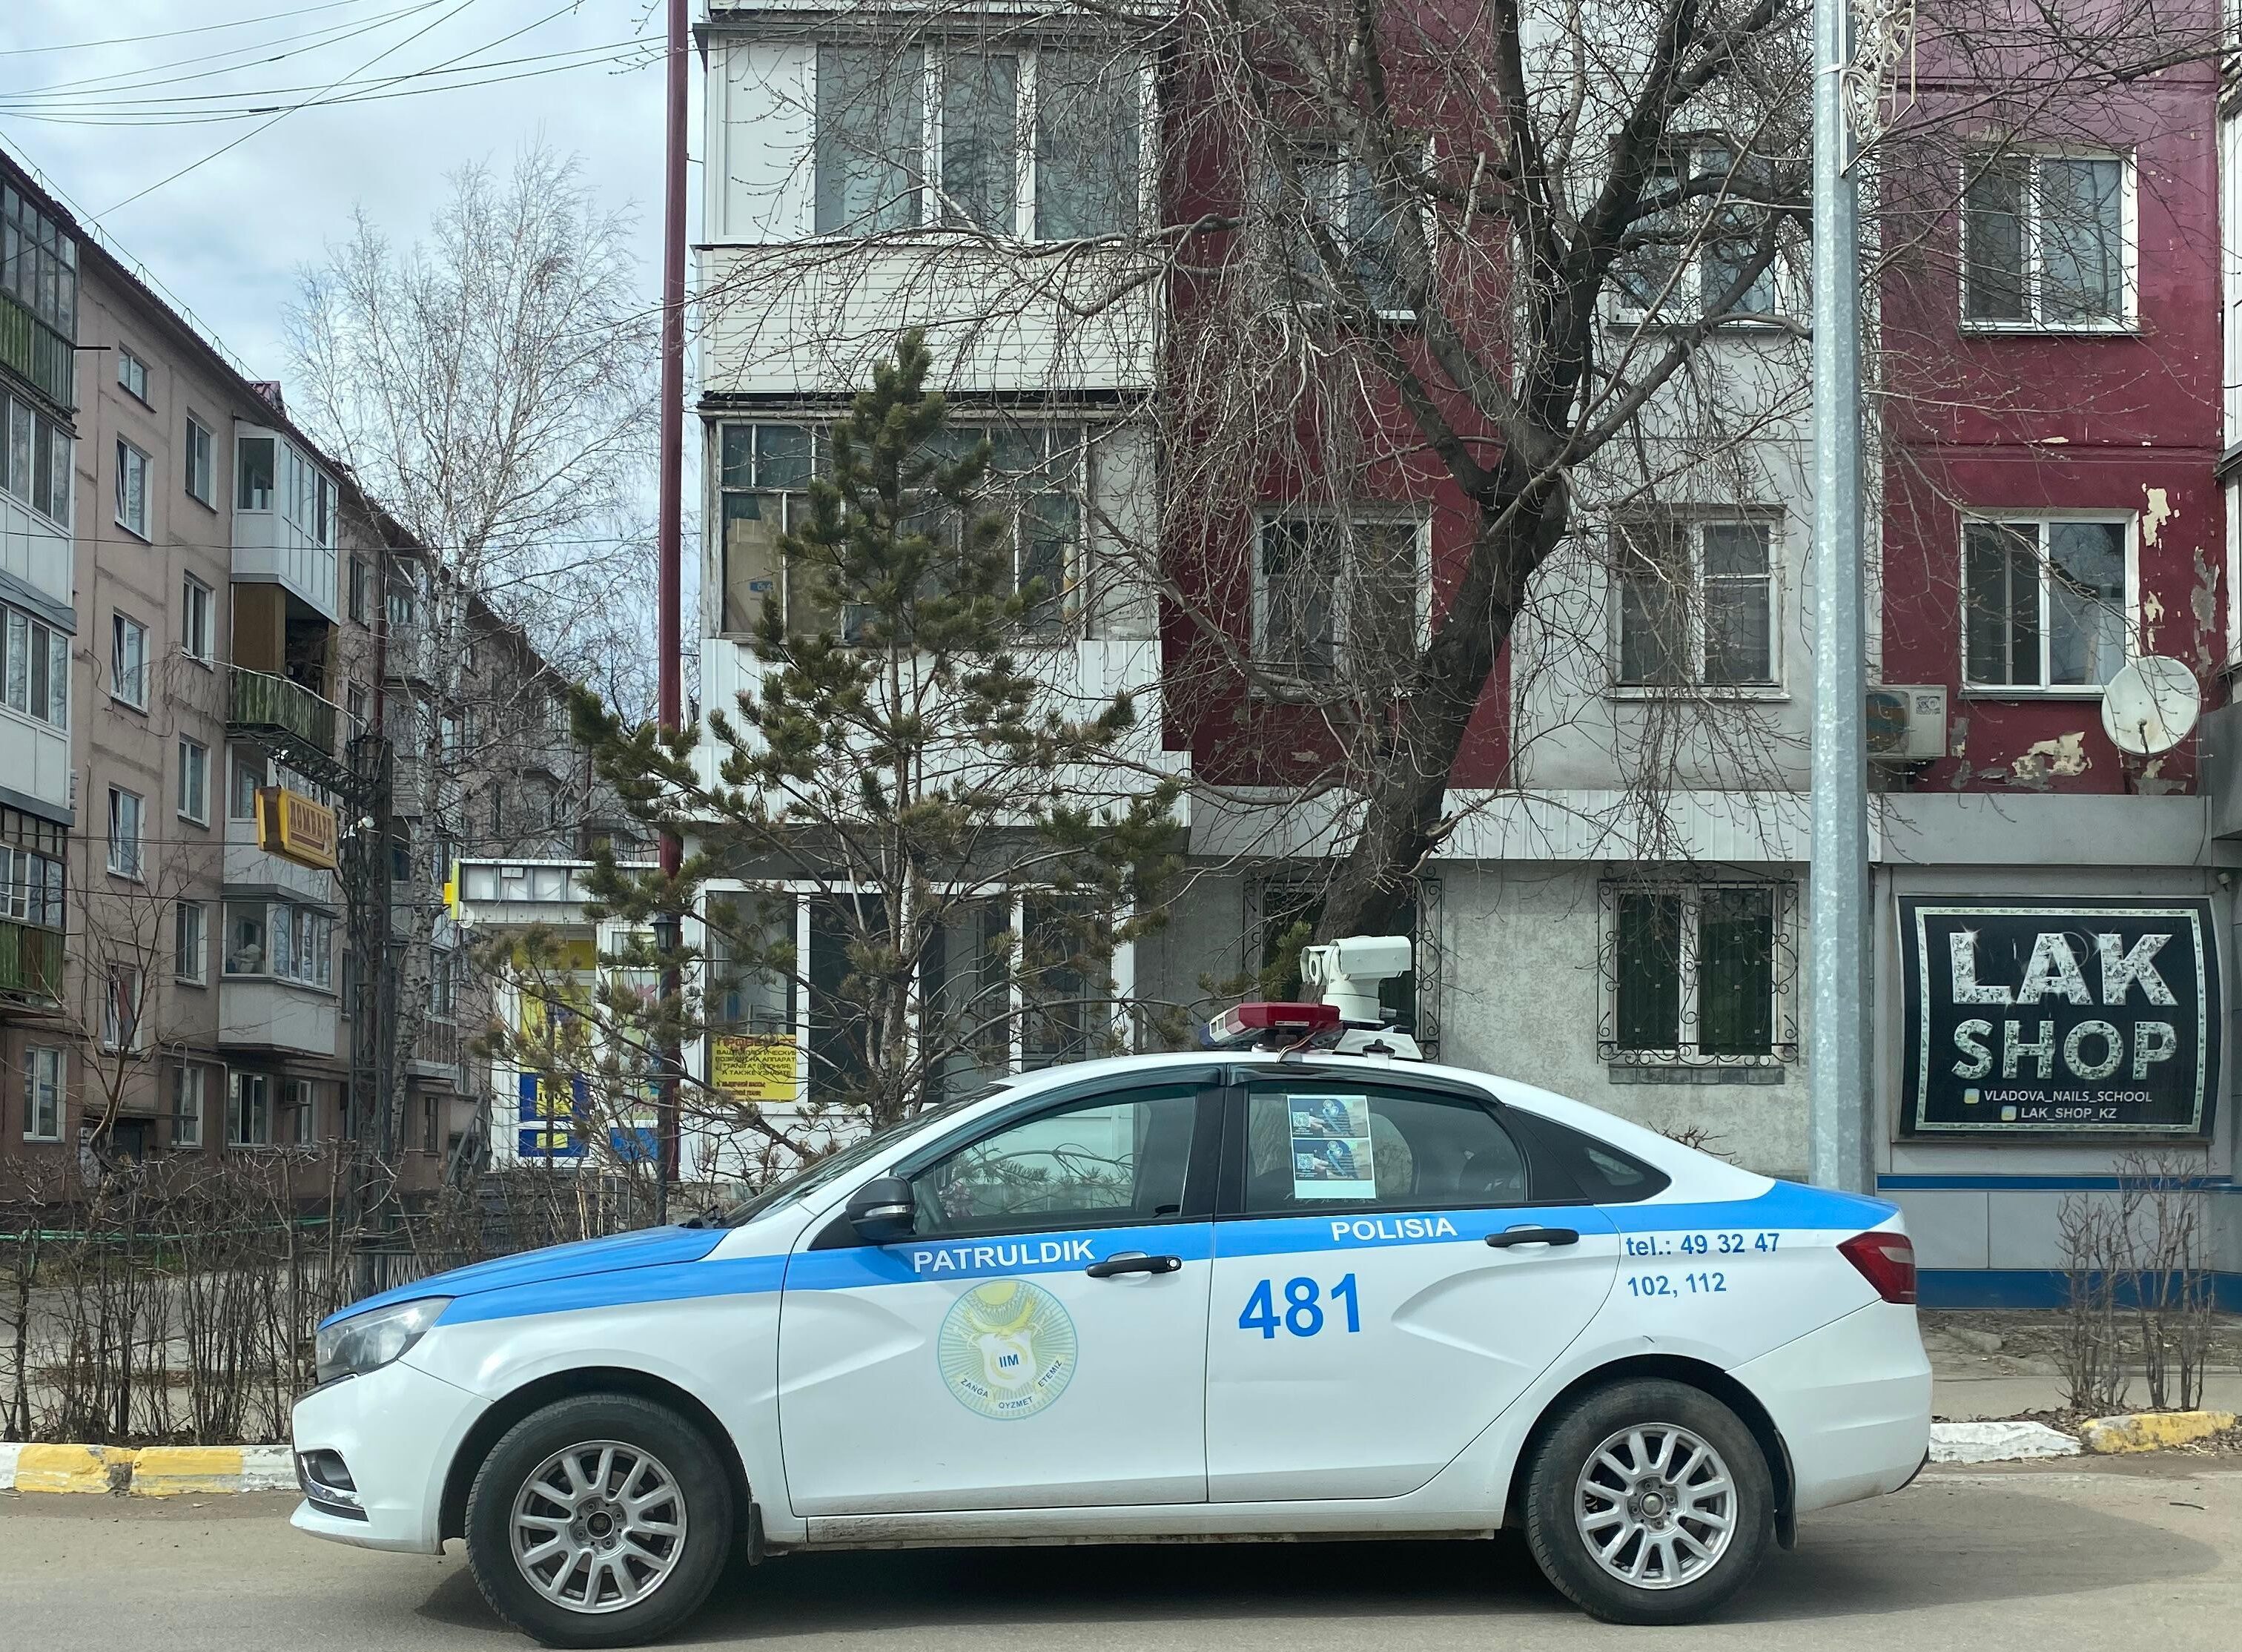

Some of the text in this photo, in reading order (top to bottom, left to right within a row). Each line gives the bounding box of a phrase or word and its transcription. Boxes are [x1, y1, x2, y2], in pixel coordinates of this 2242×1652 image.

[1949, 932, 2179, 1006] LAK
[1951, 1019, 2178, 1080] SHOP
[1984, 1090, 2152, 1103] VLADOVA_NAILS_SCHOOL
[2021, 1107, 2117, 1122] LAK_SHOP_KZ
[1331, 1217, 1458, 1241] POLISIA
[913, 1239, 1095, 1273] PATRULDIK
[1626, 1233, 1779, 1256] tel.: 49 32 47
[1627, 1272, 1727, 1298] 102, 112
[1239, 1273, 1360, 1339] 481
[999, 1354, 1019, 1367] IIM
[1038, 1360, 1062, 1387] ETEMIZ
